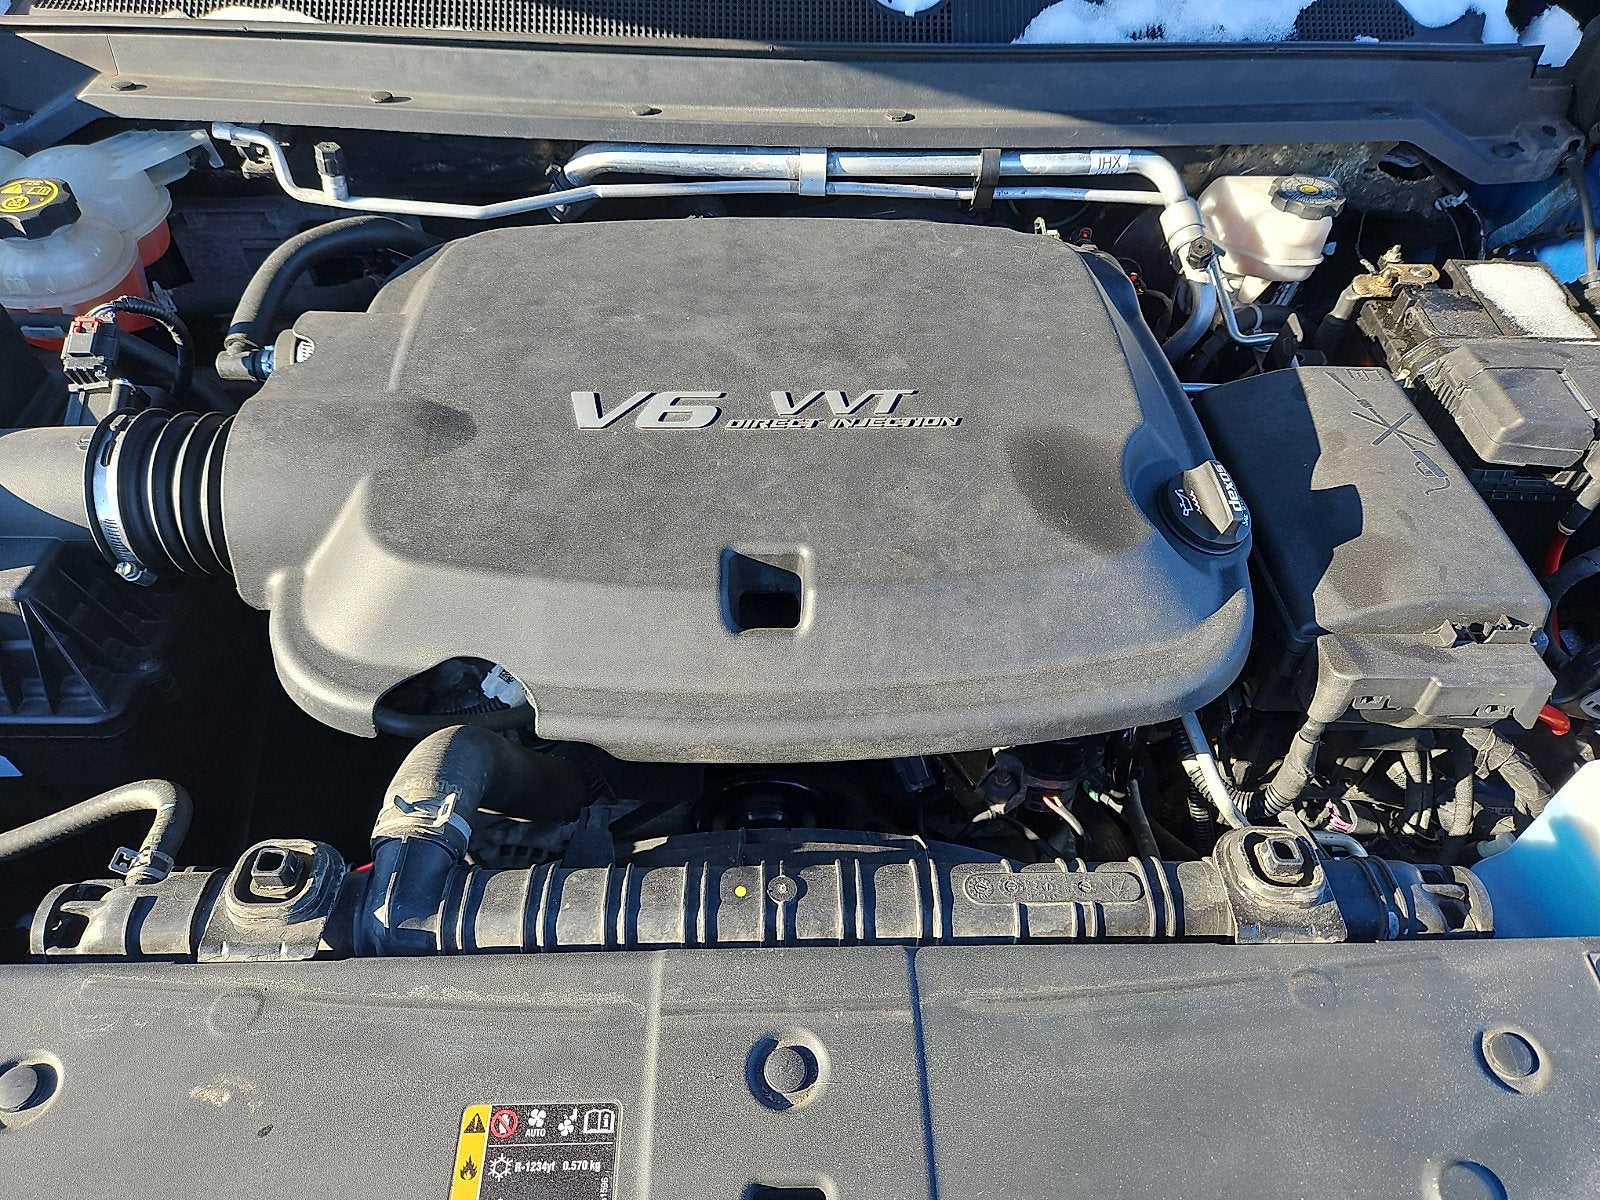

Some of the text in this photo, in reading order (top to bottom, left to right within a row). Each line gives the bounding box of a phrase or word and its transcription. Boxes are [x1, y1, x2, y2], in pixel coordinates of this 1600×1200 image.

[571, 391, 727, 430] V6
[770, 390, 919, 416] VVT
[725, 417, 963, 430] DIRECT INJECTION
[1213, 462, 1244, 512] dexos
[524, 1128, 546, 1138] AUTO
[562, 1160, 588, 1171] 0.570
[589, 1160, 601, 1173] kg
